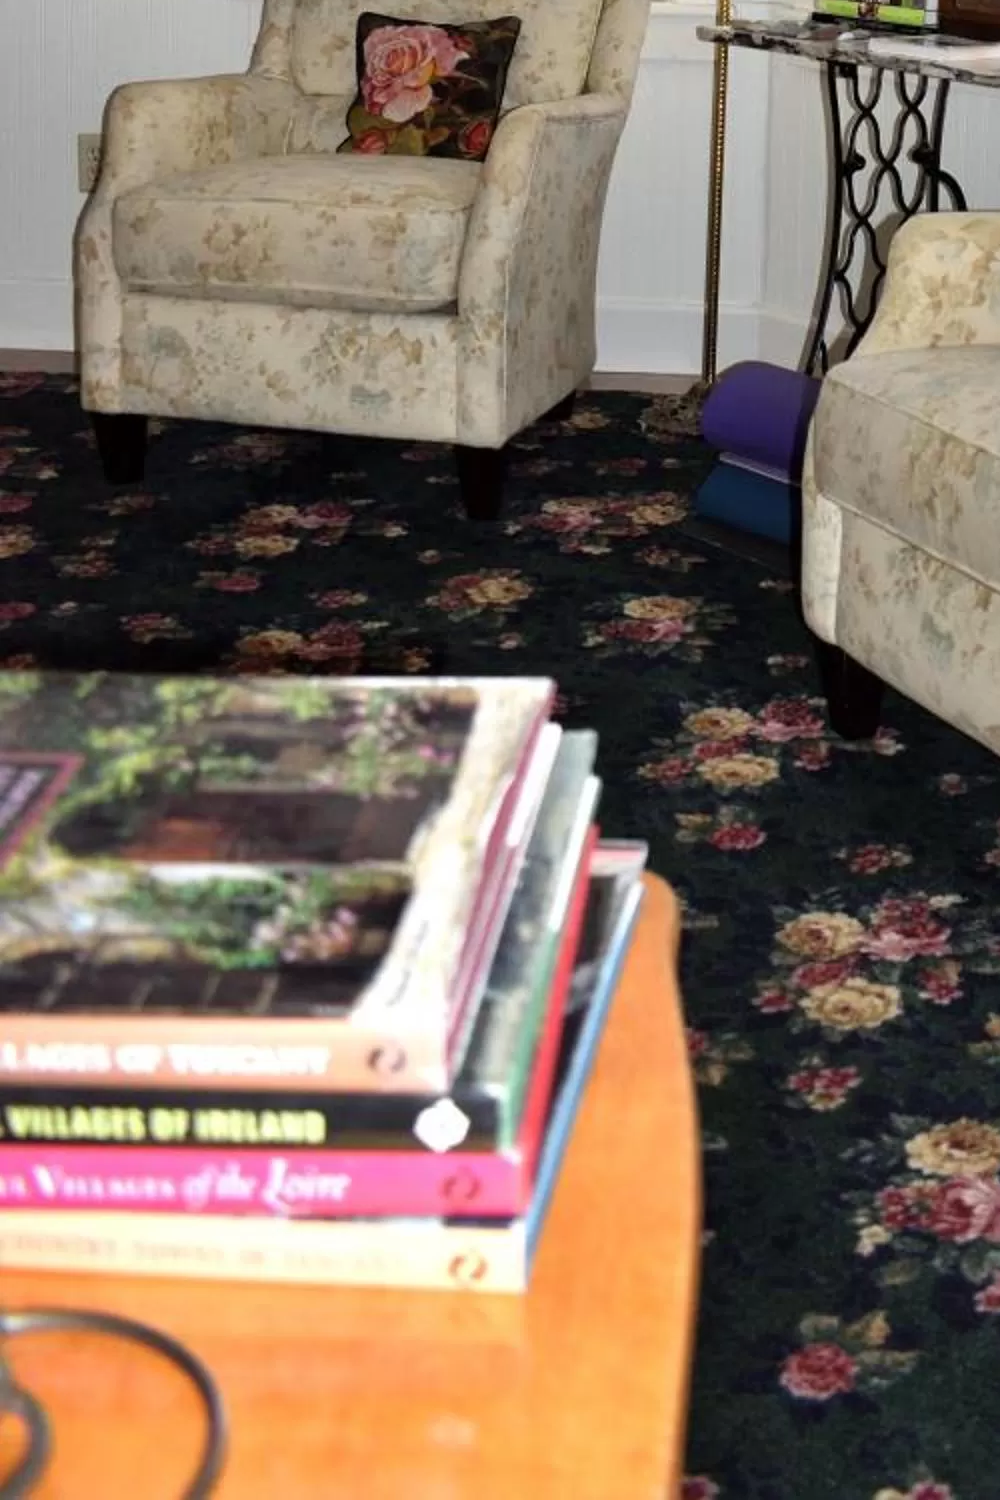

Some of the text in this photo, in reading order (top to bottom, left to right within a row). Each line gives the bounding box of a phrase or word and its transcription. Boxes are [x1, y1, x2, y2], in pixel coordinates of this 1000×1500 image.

[6, 1105, 328, 1145] VILLAGES OF IRELAND
